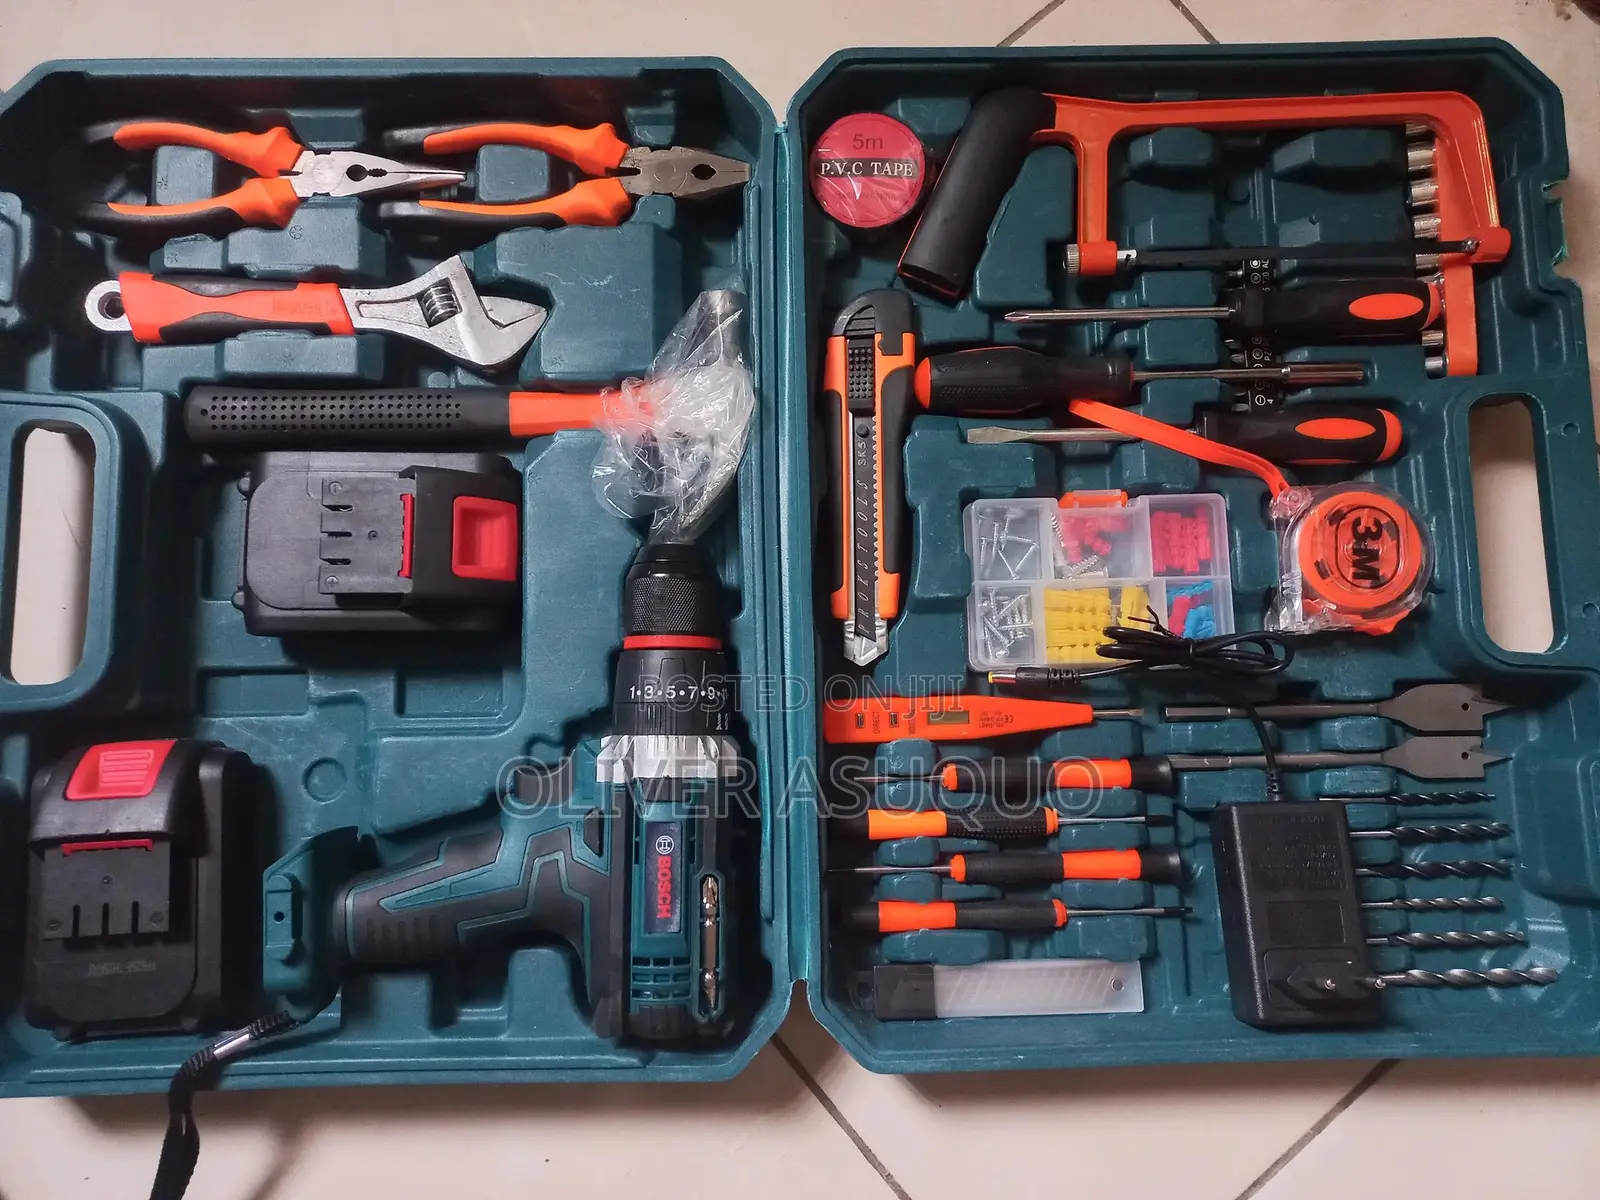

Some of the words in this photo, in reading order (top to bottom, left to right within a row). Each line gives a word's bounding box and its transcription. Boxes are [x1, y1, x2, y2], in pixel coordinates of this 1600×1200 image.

[852, 134, 883, 149] 5m
[820, 161, 863, 176] P.V.C
[869, 161, 914, 177] TAPE
[656, 855, 673, 919] BOSCH
